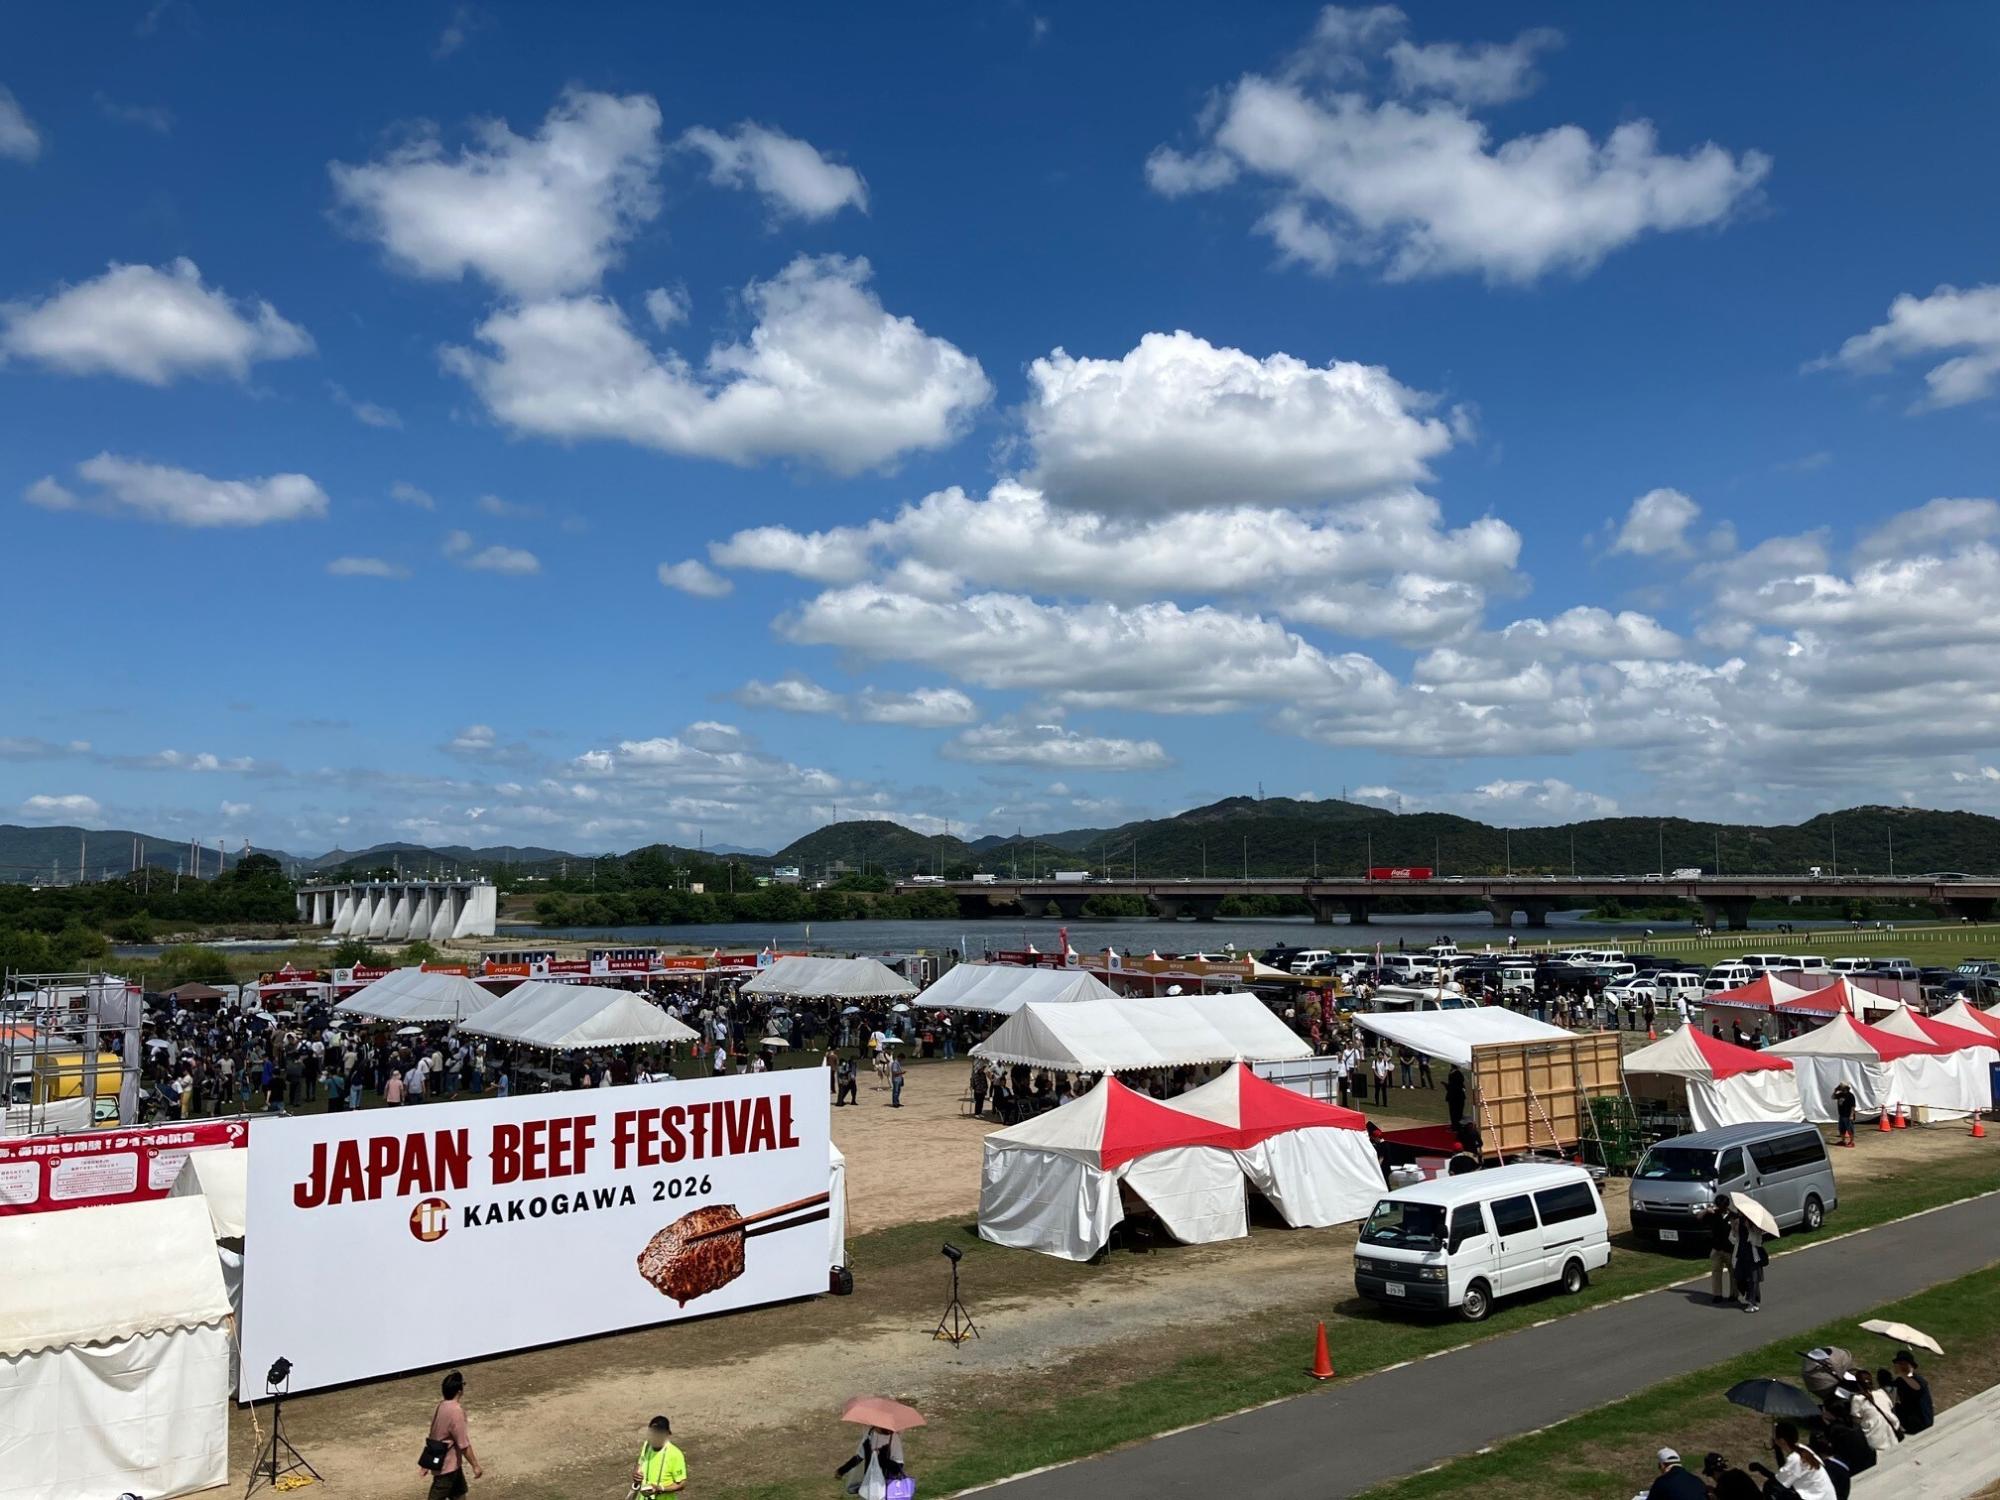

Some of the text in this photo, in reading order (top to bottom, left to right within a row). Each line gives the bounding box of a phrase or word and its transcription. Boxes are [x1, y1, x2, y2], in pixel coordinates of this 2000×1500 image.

[294, 1095, 800, 1209] JAPAN BEEF FESTIVAL
[464, 1185, 637, 1228] KAKOGAWA
[653, 1174, 713, 1202] 2026
